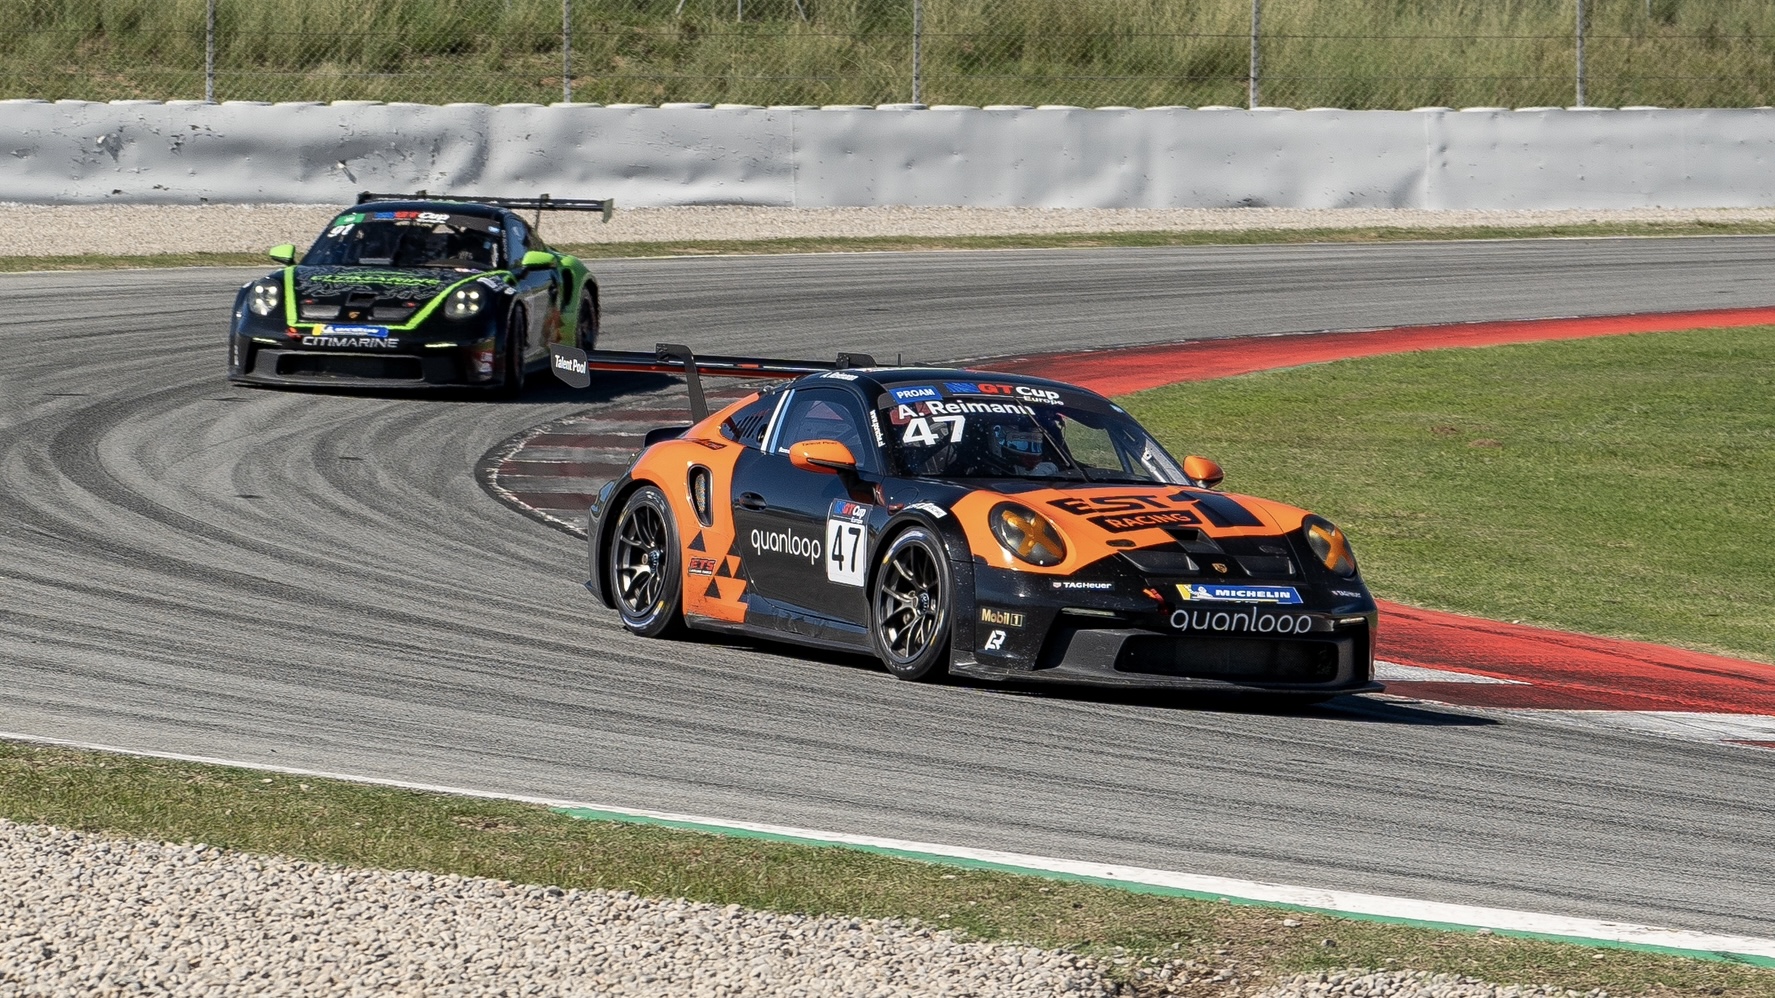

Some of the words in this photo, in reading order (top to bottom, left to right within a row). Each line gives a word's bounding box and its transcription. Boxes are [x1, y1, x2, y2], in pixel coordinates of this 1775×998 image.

[302, 336, 399, 348] CITIMARINE
[554, 354, 573, 371] Talent
[572, 359, 587, 374] Pool
[896, 388, 936, 399] PROAM
[978, 383, 1013, 394] GT
[1016, 386, 1060, 399] Cup
[1024, 395, 1064, 406] Europe
[899, 404, 926, 419] A.
[930, 400, 1036, 415] Reimann
[902, 415, 966, 450] 47
[853, 505, 866, 519] Cup
[1106, 513, 1192, 528] RACING
[751, 528, 821, 565] quanloop
[832, 525, 861, 572] 47
[691, 560, 714, 570] ETS
[1215, 589, 1291, 598] MICHELIN
[982, 608, 1010, 625] Mobil
[1170, 606, 1312, 635] quanloop
